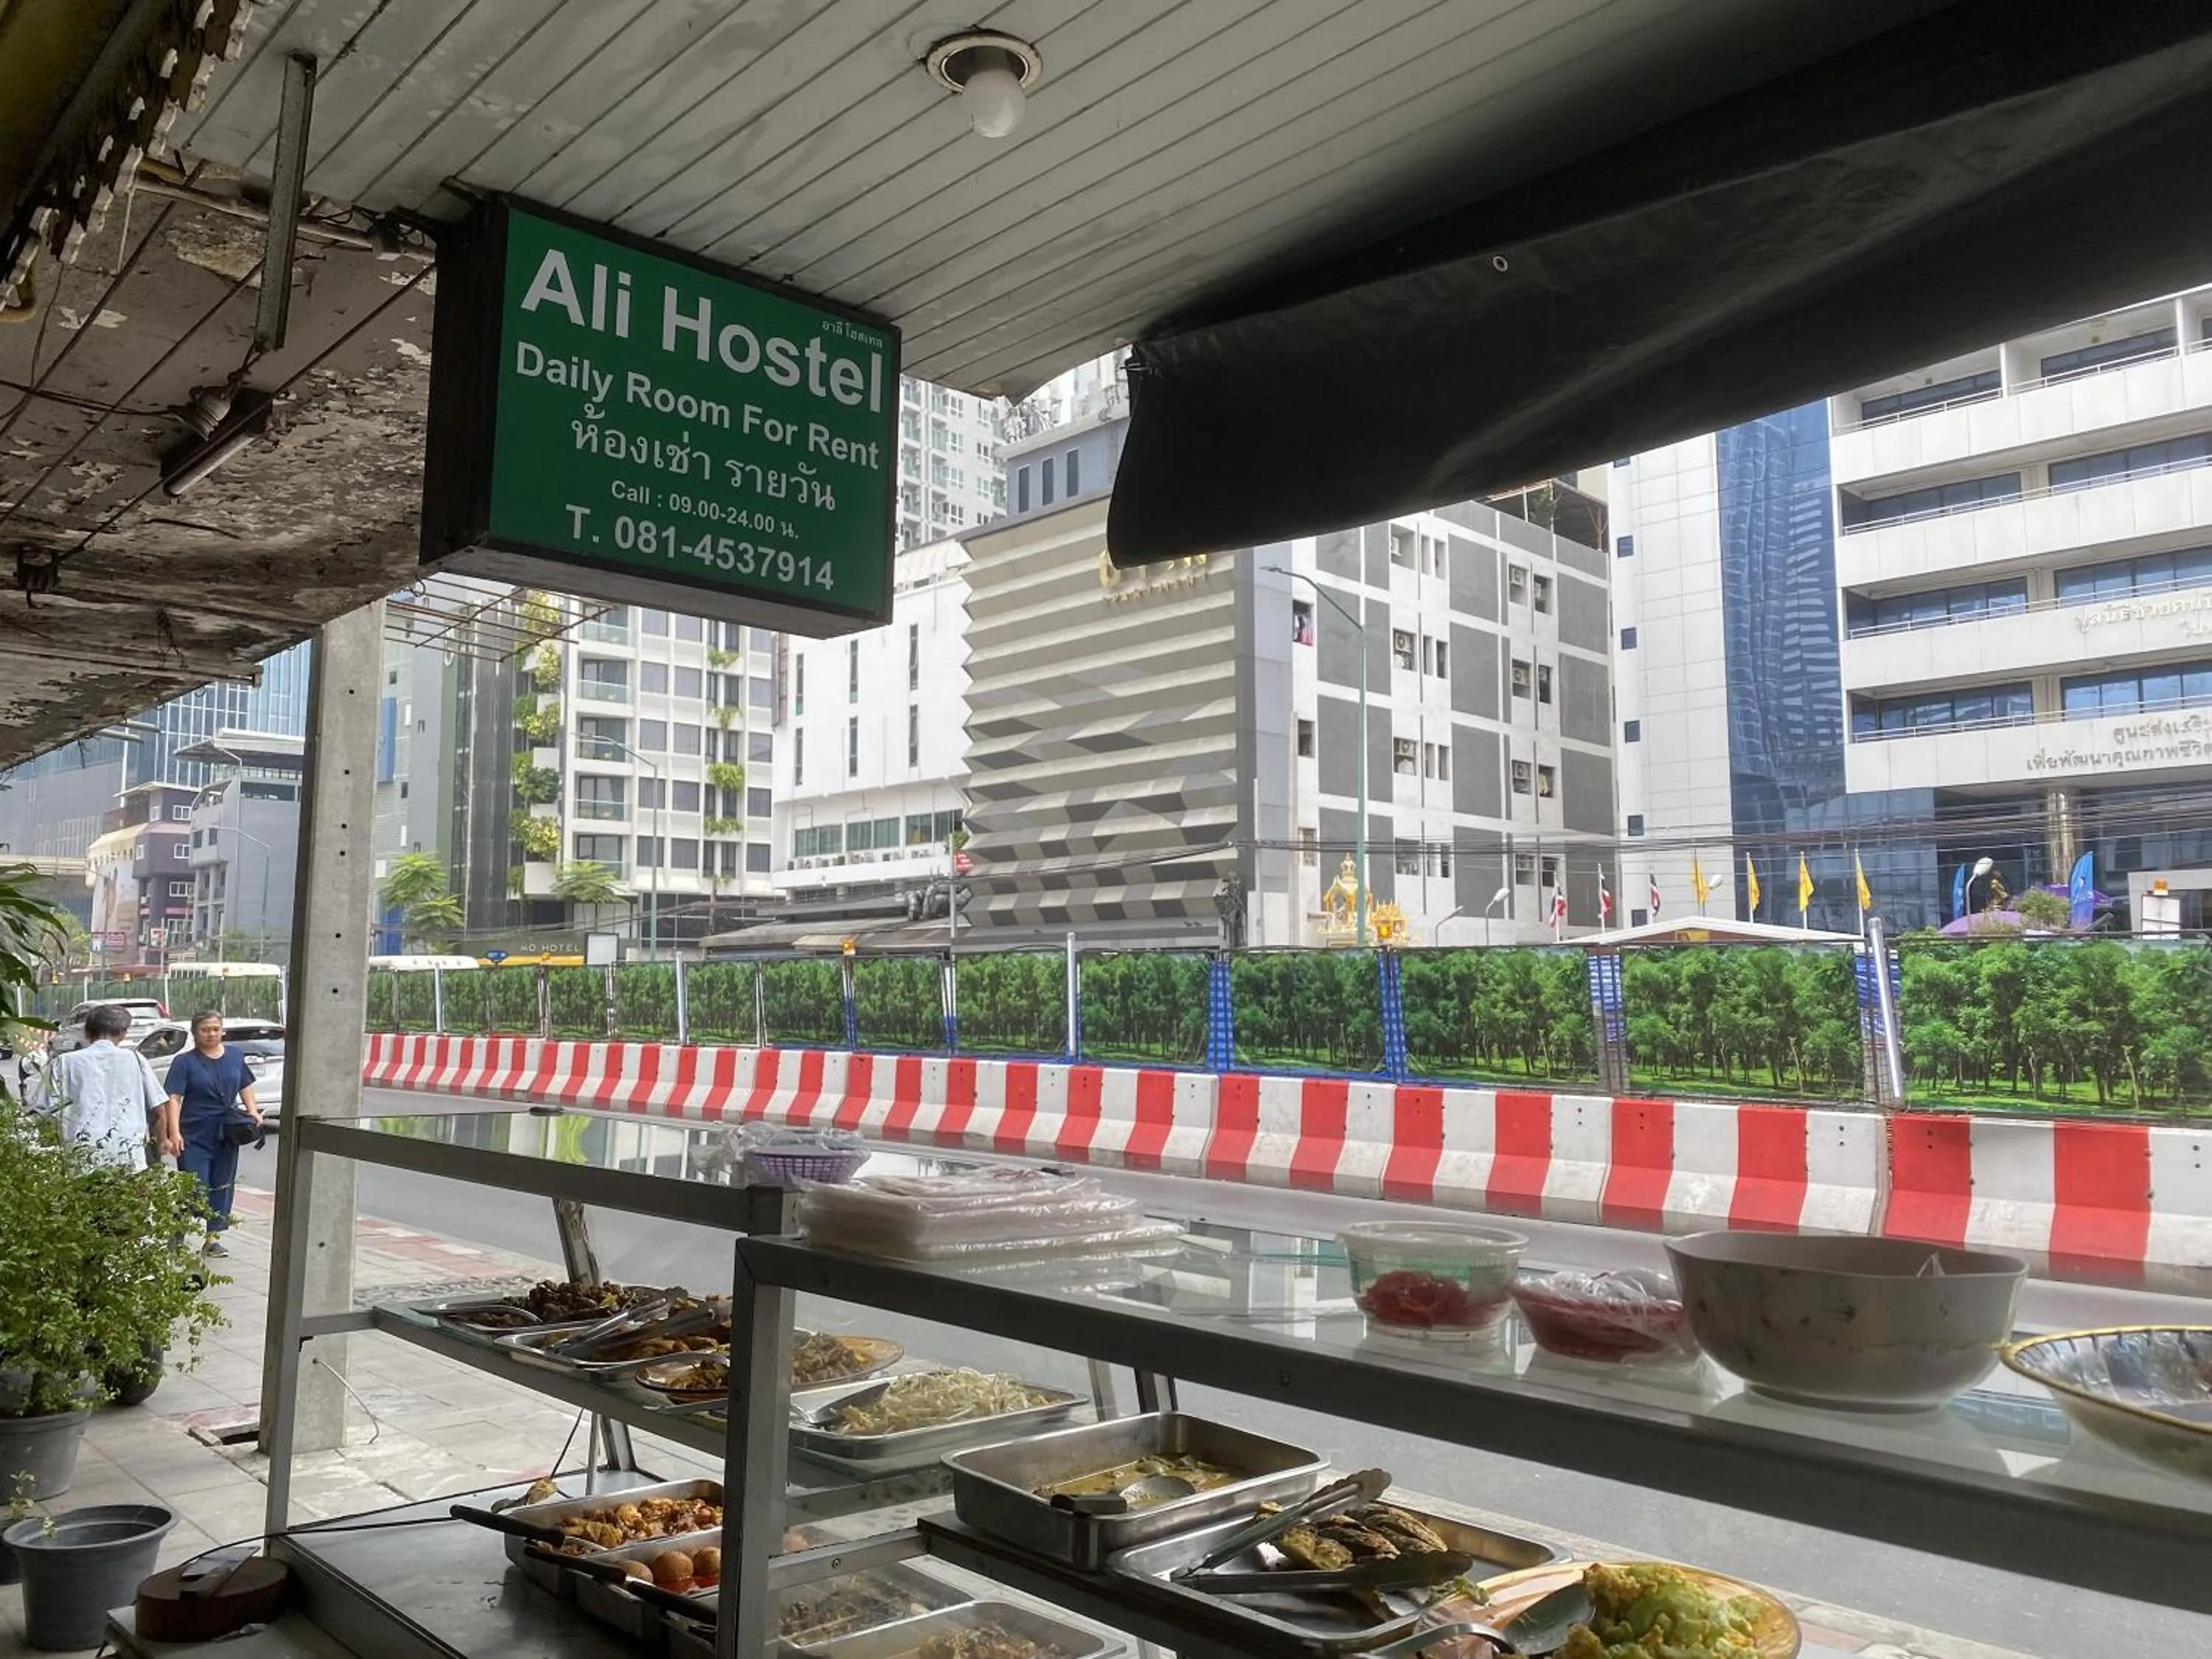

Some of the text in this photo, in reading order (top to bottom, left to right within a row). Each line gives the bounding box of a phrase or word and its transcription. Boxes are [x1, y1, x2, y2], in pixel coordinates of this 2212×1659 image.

[521, 248, 883, 413] Ali Hostel
[517, 341, 879, 470] Daily Room For Rent
[571, 403, 836, 511] ห้องเช่า รายวัน
[566, 504, 834, 591] T. 081-4537914
[611, 480, 650, 505] Call
[669, 493, 775, 534] 09.00-24.00
[541, 943, 579, 953] HOTEL
